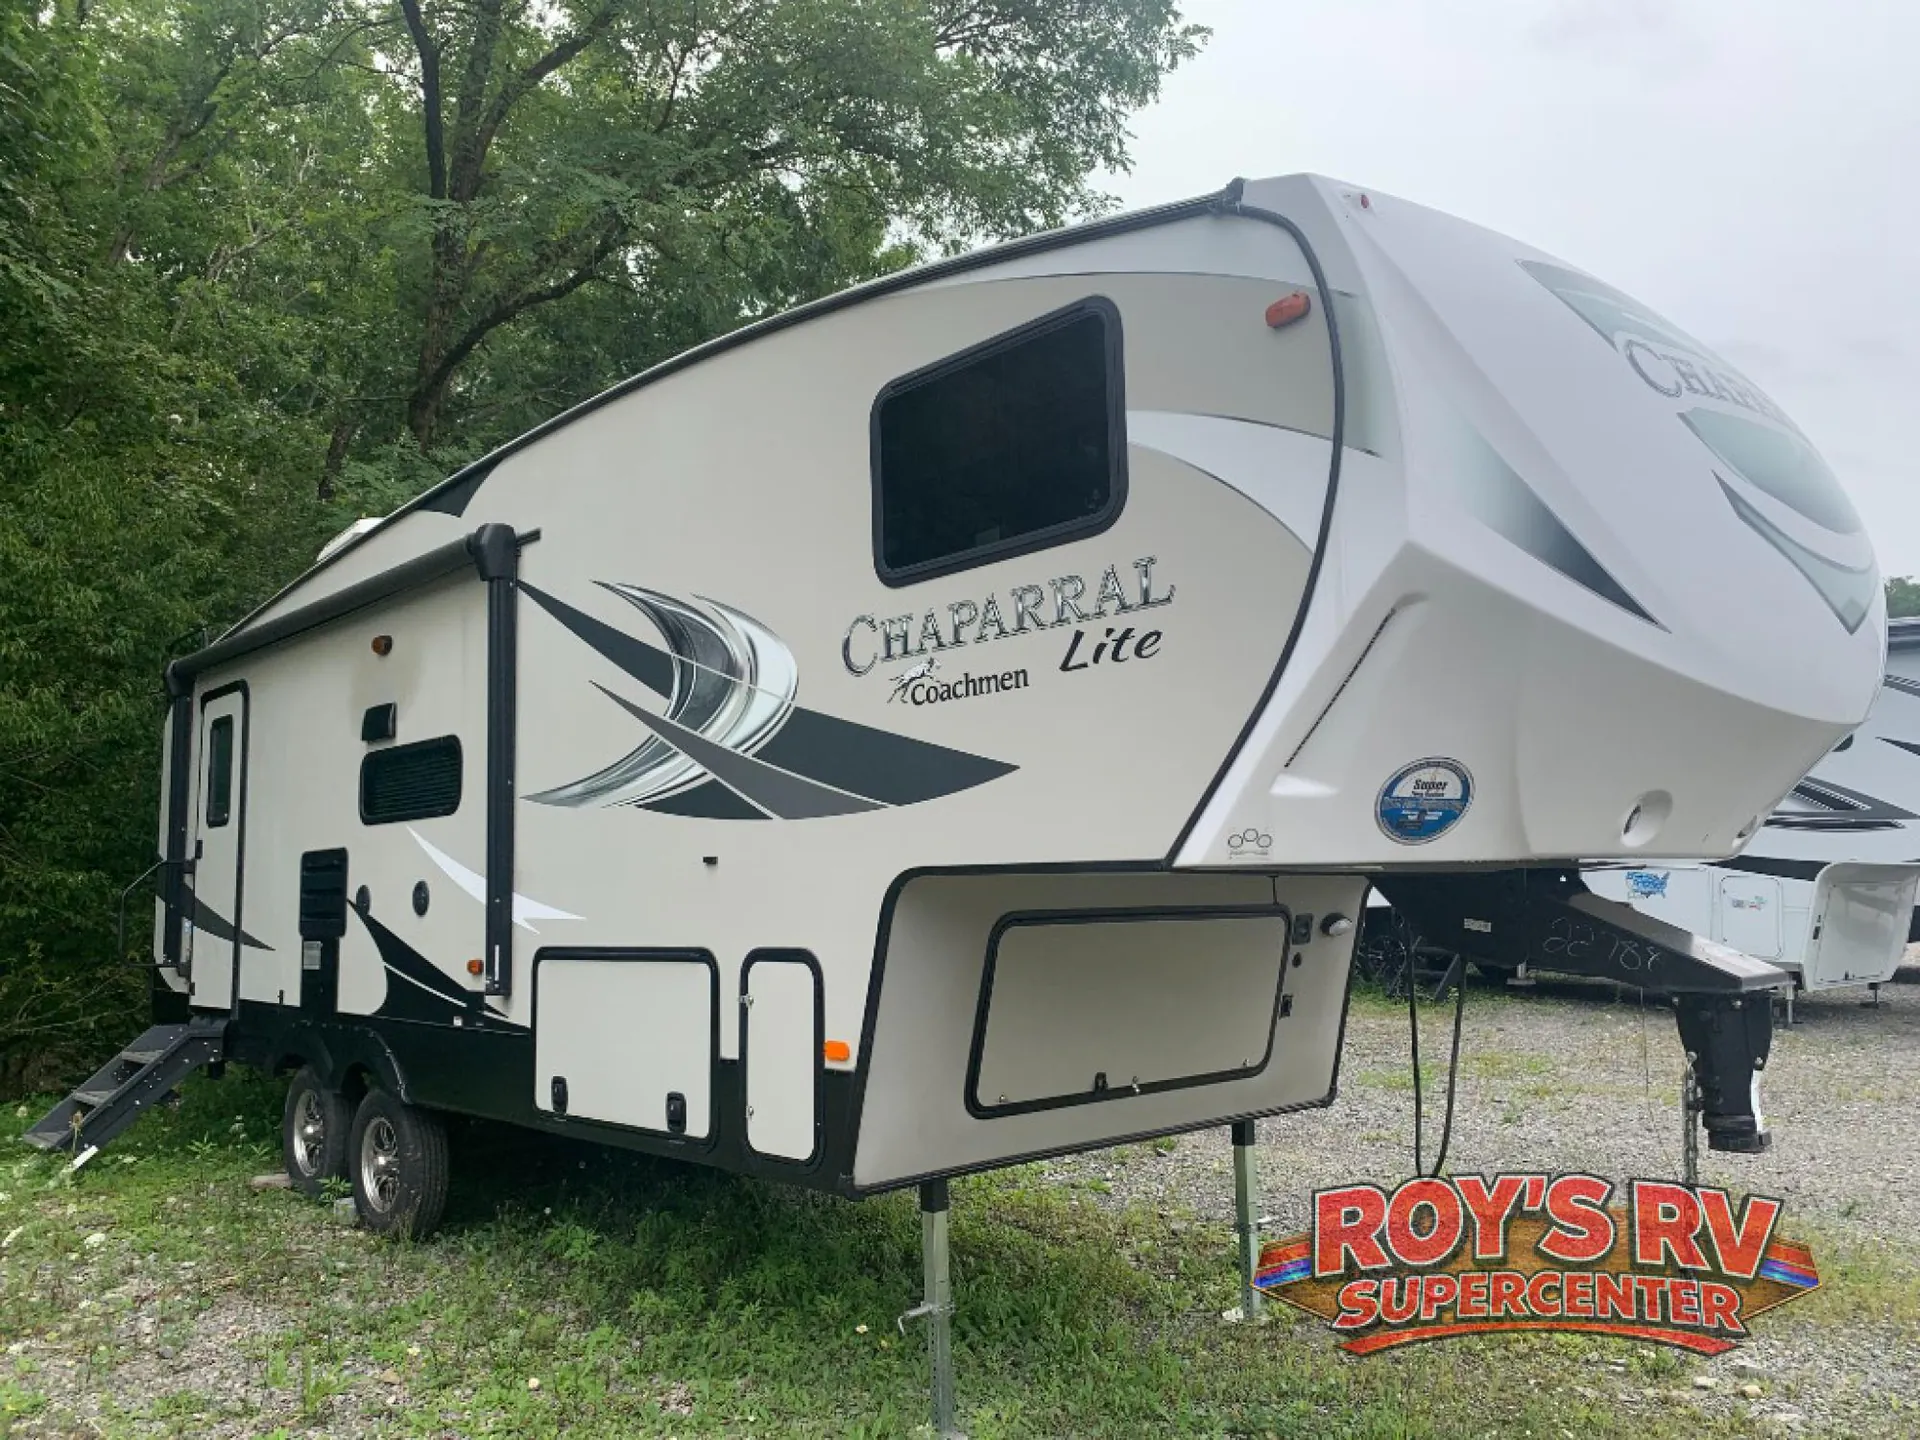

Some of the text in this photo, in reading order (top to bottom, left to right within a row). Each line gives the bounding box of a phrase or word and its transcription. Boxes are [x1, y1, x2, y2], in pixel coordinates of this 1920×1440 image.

[841, 554, 1177, 677] CHAPARRAL
[1058, 627, 1164, 672] Lite
[910, 667, 1030, 706] Coachmen
